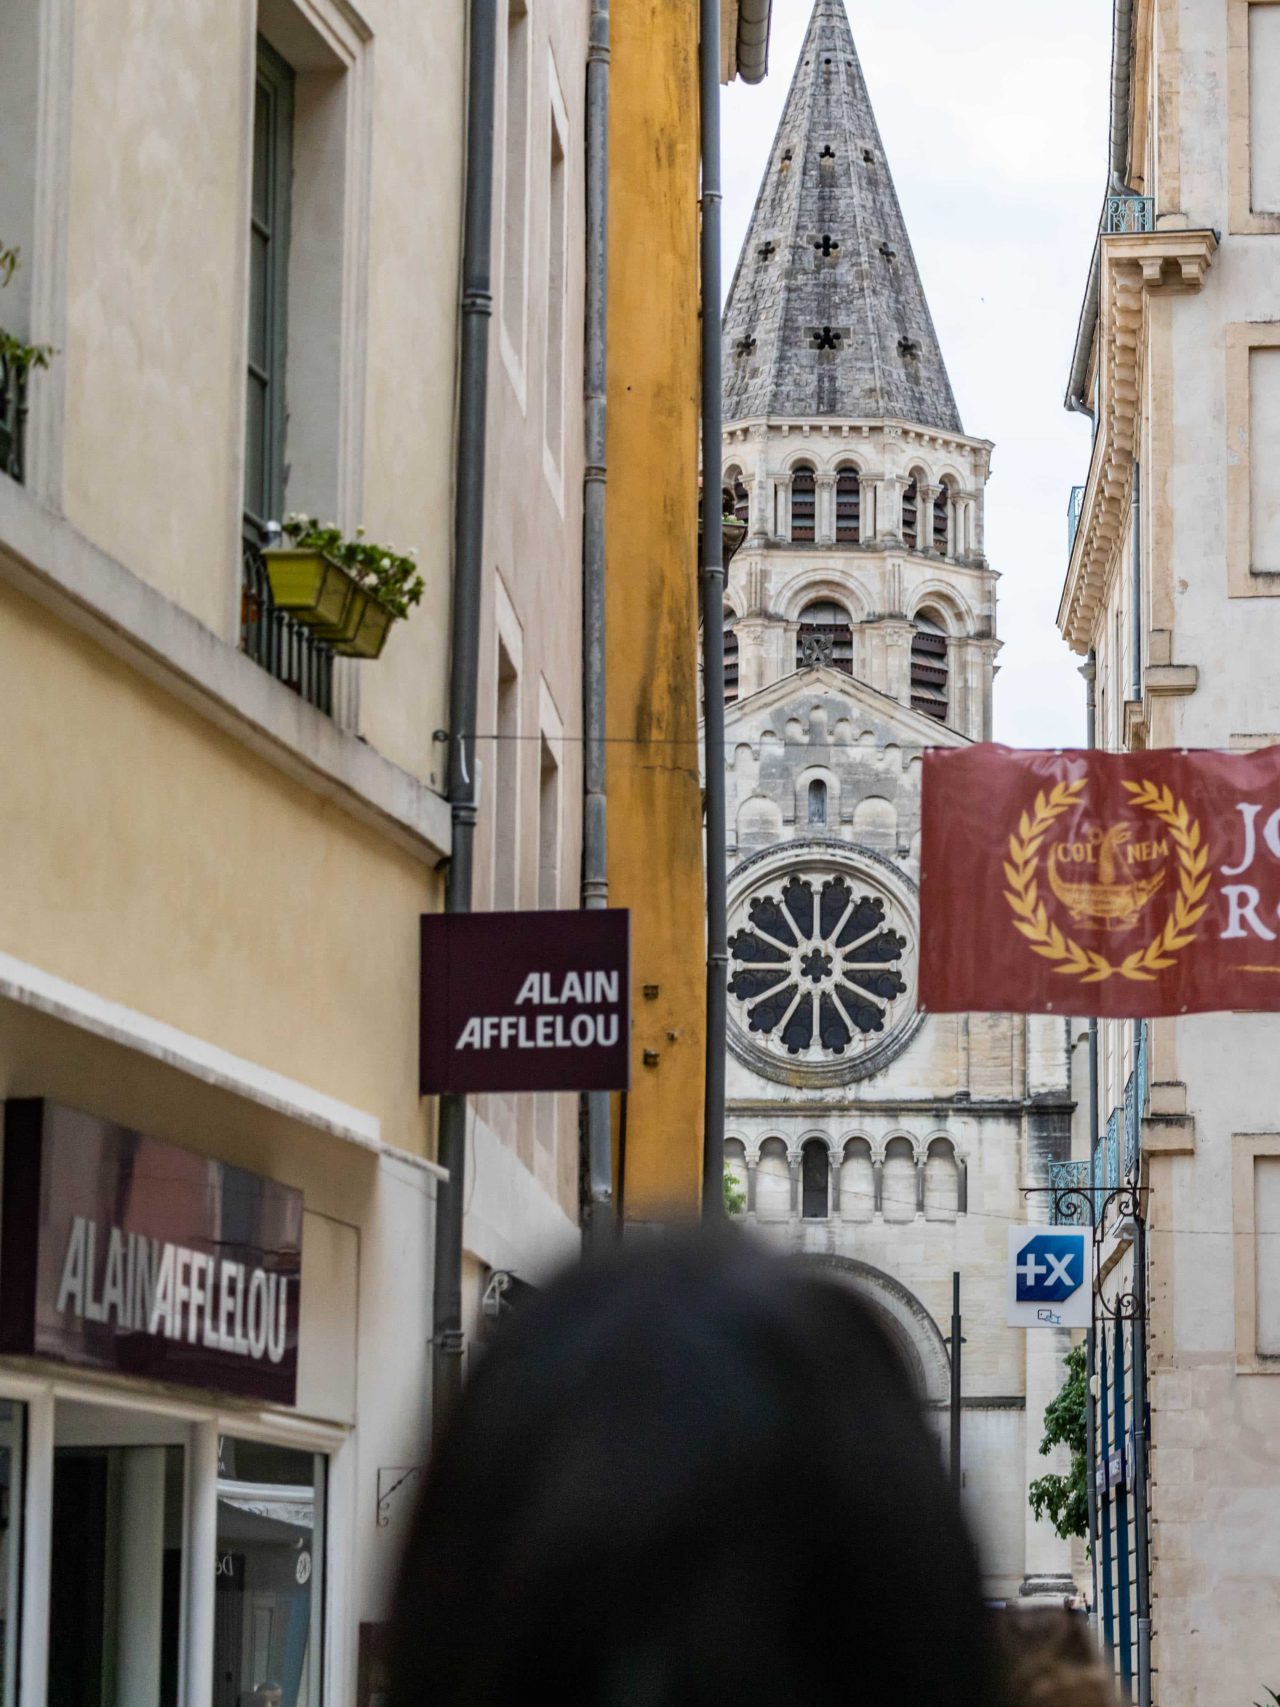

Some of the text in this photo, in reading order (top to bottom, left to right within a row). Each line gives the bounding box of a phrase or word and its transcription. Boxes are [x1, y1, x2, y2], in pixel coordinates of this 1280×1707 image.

[1126, 840, 1169, 865] NEM
[514, 970, 619, 1005] ALAIN
[455, 1013, 619, 1050] AFFLELOU
[56, 1216, 288, 1364] ALAIN AFFLELOU
